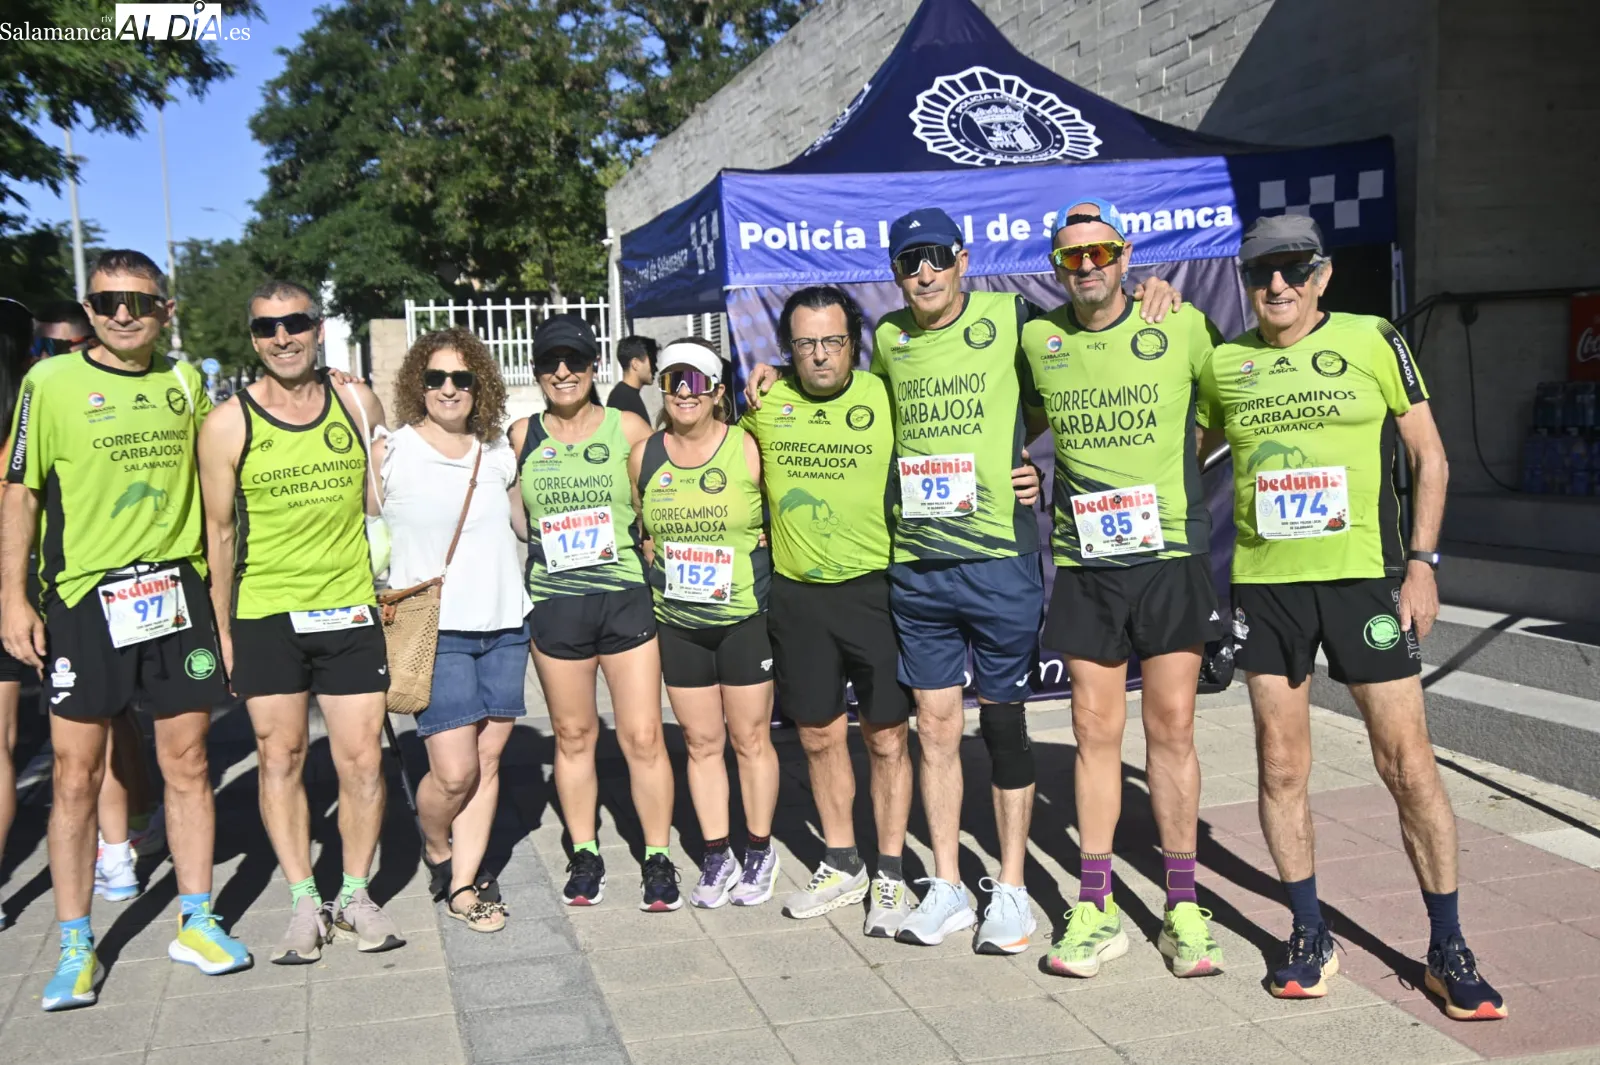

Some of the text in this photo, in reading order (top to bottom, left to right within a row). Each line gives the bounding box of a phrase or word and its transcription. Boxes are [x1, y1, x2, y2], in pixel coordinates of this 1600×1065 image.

[738, 219, 867, 251] Policía
[986, 214, 1031, 242] de
[1043, 204, 1234, 239] Smanca
[1392, 336, 1416, 387] CARBAJOSA
[897, 372, 987, 402] CORRECAMINOS
[1050, 383, 1159, 412] CORRECAMINOS
[899, 398, 985, 426] CARBAJOSA
[1233, 390, 1357, 415] CORRECAMINOS
[1051, 408, 1157, 436] CARBAJOSA
[1240, 404, 1341, 428] CARBAJOSA
[12, 392, 31, 471] CORRECAMINOS
[92, 429, 189, 449] CORRECAMINOS
[902, 422, 983, 441] SALAMANCA
[1253, 421, 1325, 437] SALAMANCA
[769, 441, 873, 455] CORRECAMINOS
[1059, 432, 1156, 450] SALAMANCA
[110, 444, 185, 462] CARBAJOSA
[776, 455, 858, 469] CARBAJOSA
[124, 459, 178, 473] SALAMANCA
[251, 458, 361, 485] CORRECAMINOS
[787, 469, 845, 480] SALAMANCA
[901, 458, 972, 476] bedunia
[270, 476, 354, 497] CARBAJOSA
[533, 474, 614, 491] CORRECAMINOS
[921, 477, 950, 500] 95
[287, 494, 344, 509] SALAMANCA
[536, 489, 612, 506] CARBAJOSA
[1073, 490, 1154, 515] bedunia
[1274, 491, 1328, 519] 174
[650, 505, 728, 522] CORRECAMINOS
[1100, 511, 1133, 537] 85
[653, 520, 727, 535] CARBAJOSA
[661, 533, 725, 543] SALAMANCA
[557, 527, 599, 553] 147
[676, 563, 717, 587] 152
[134, 595, 164, 622] 97
